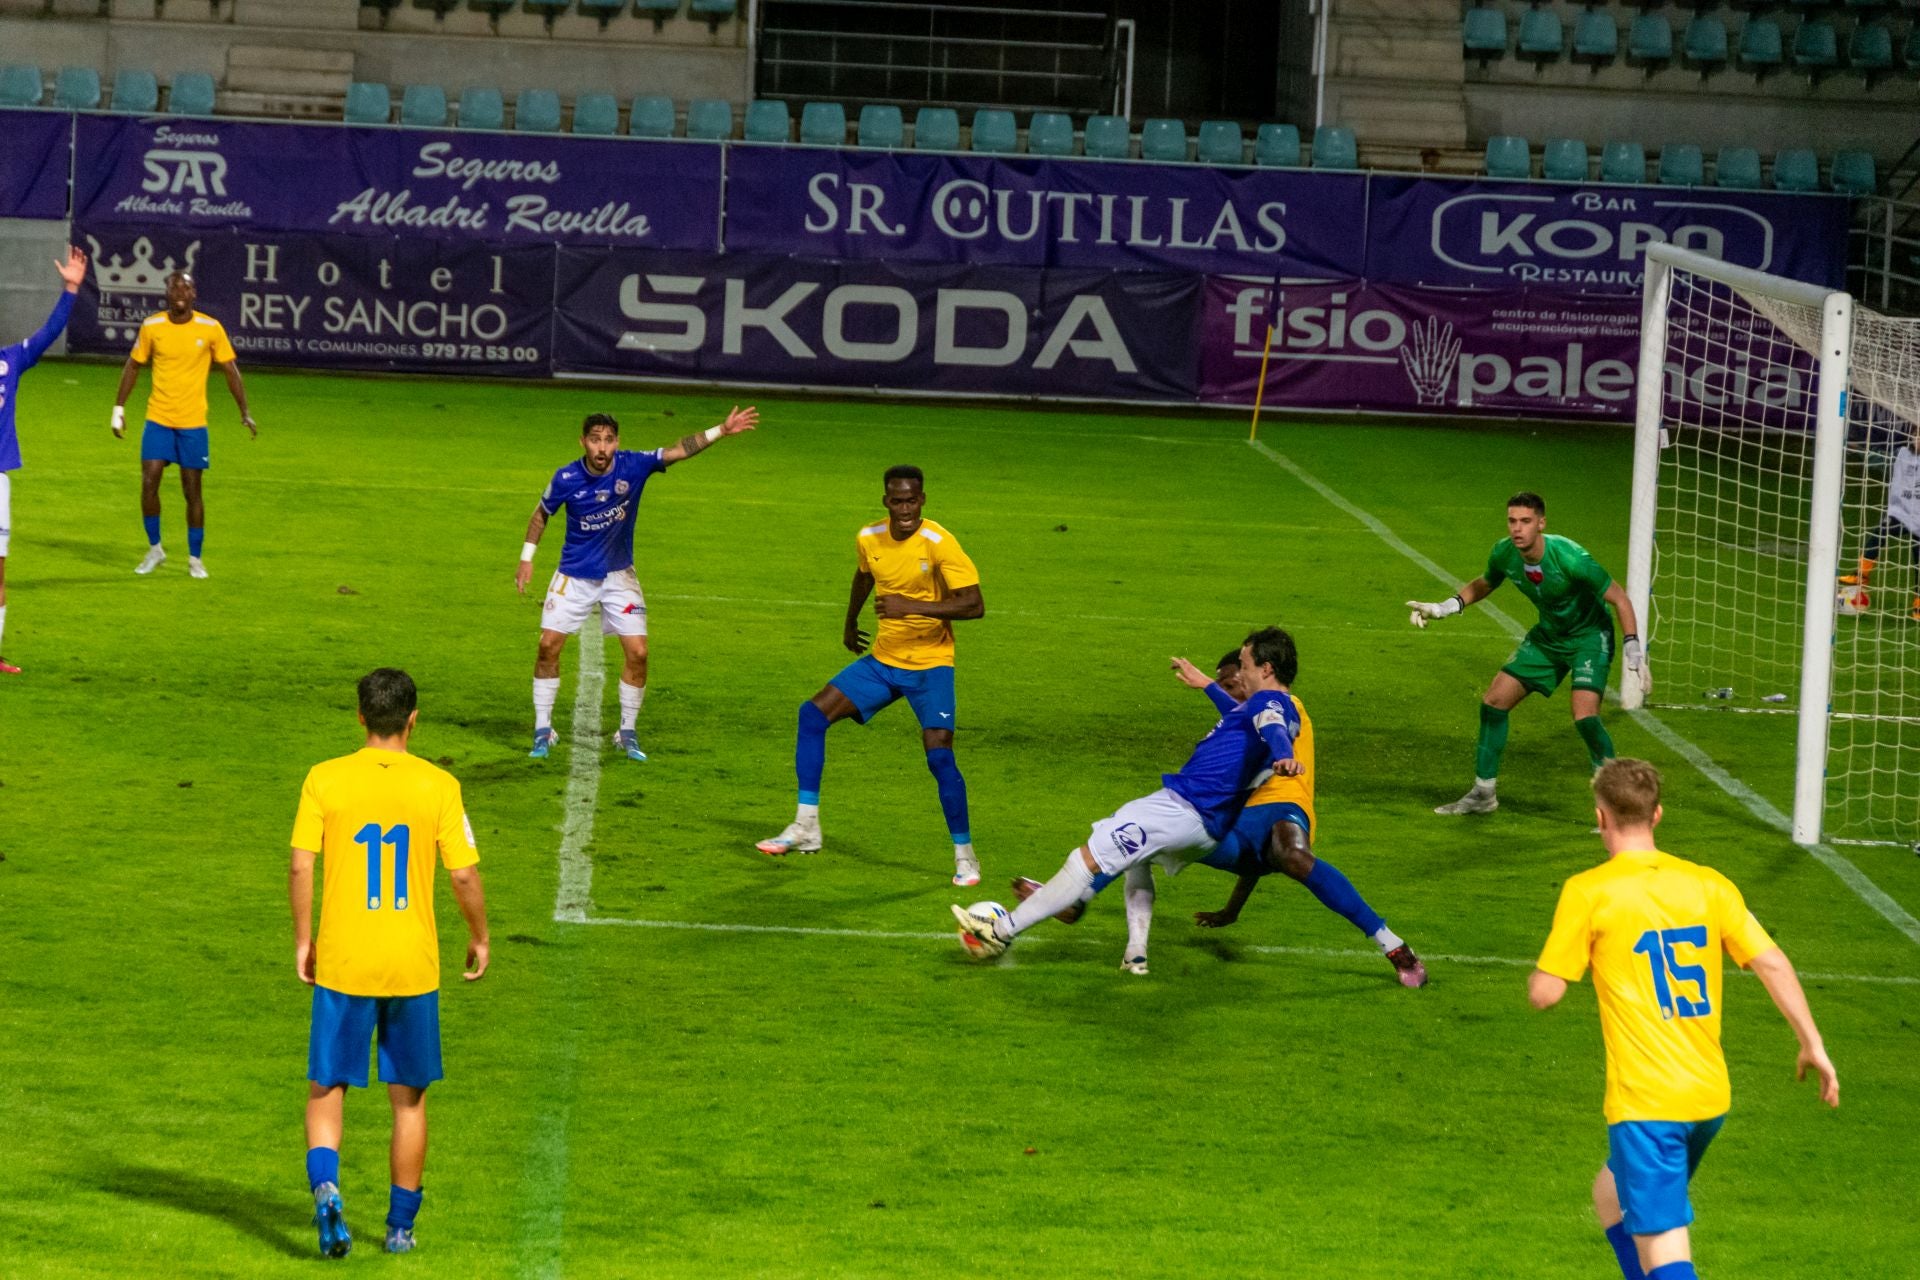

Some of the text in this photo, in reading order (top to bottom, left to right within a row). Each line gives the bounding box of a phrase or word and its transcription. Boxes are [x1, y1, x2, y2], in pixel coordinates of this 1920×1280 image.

[153, 125, 220, 148] Seguros
[142, 150, 228, 196] SAR
[412, 141, 561, 190] Seguros
[114, 194, 253, 217] Albadri Revilla
[327, 187, 651, 237] Albadri Revilla
[804, 172, 1288, 254] SR. CUTILLAS
[1480, 211, 1724, 261] KOPA
[97, 306, 121, 320] REY
[239, 292, 508, 340] REY SANCHO
[1492, 308, 1639, 325] centro de fisioterapia
[295, 338, 304, 349] Y
[307, 338, 417, 356] COMUNIONES
[421, 342, 456, 358] 979
[460, 344, 482, 359] 72
[485, 345, 509, 360] 53
[513, 346, 538, 362] 00
[353, 823, 410, 910] 11
[1633, 925, 1711, 1020] 15
